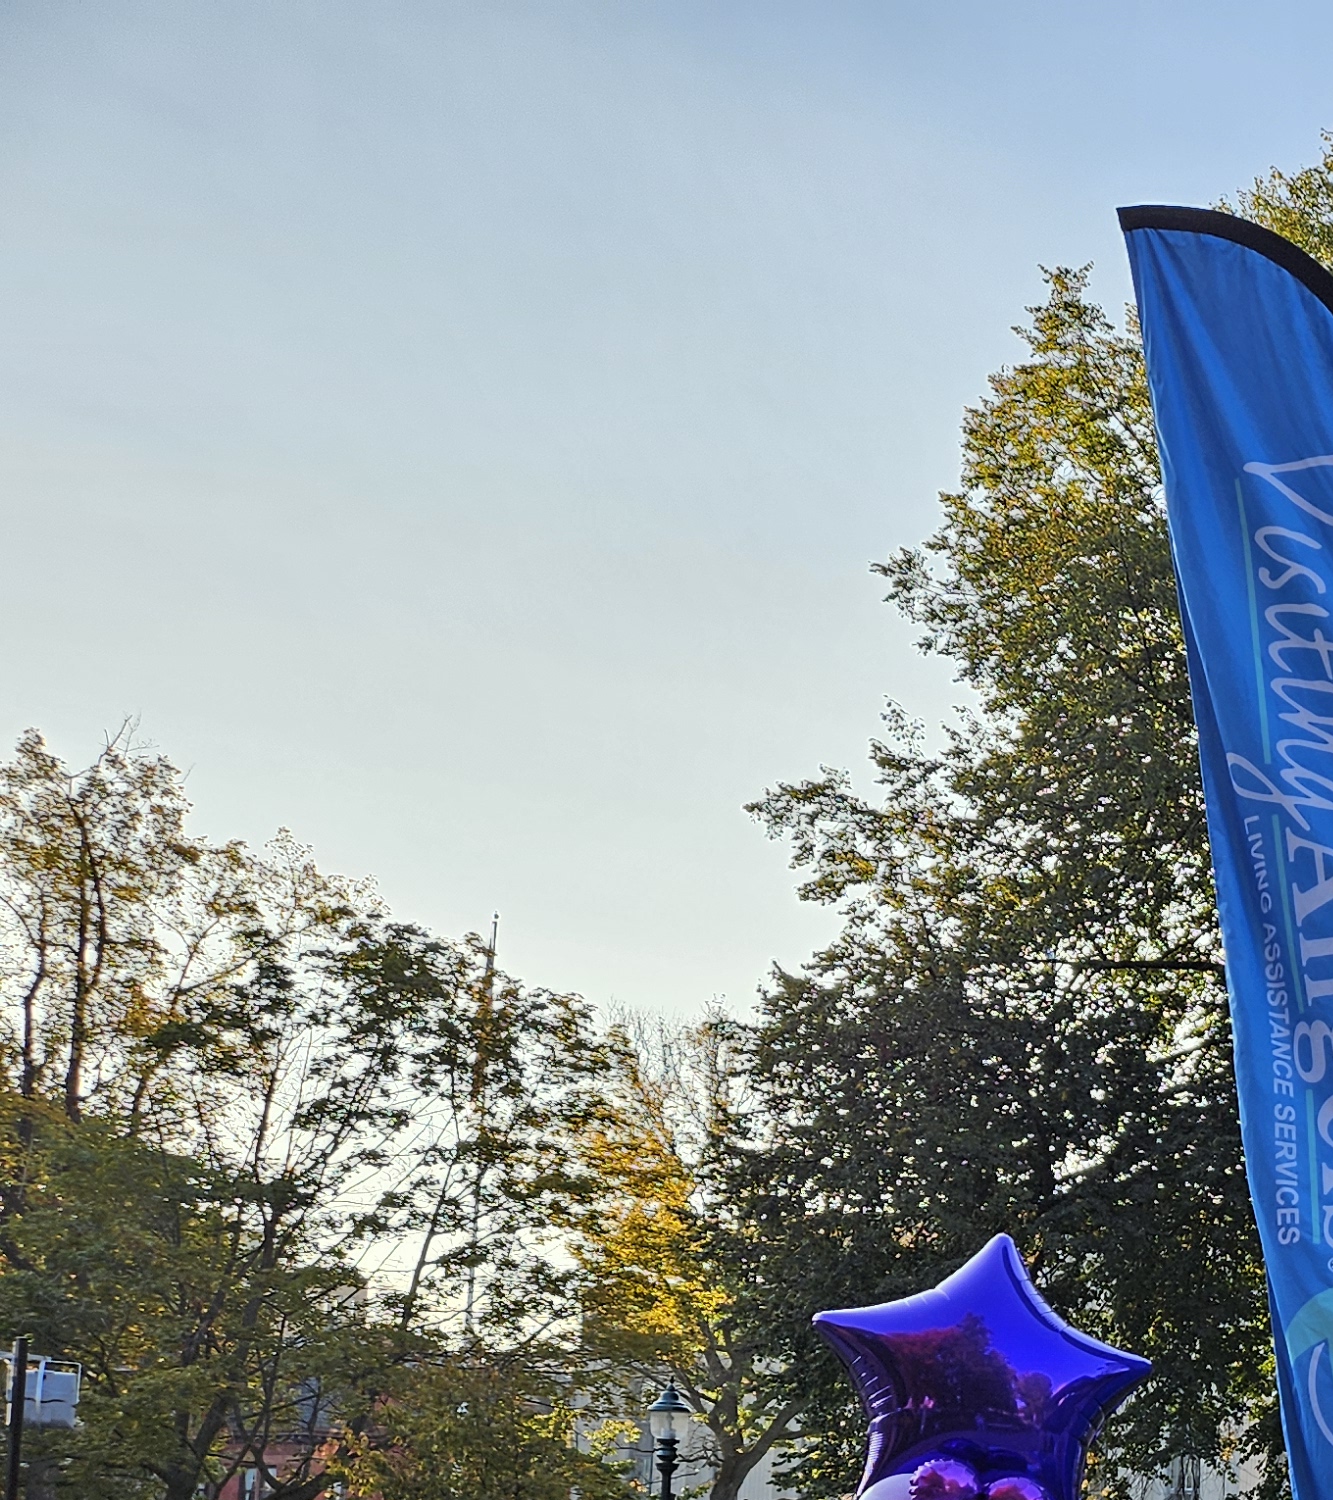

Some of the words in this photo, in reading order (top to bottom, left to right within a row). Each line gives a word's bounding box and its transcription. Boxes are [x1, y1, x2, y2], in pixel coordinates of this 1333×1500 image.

[1244, 814, 1271, 914] LIVING
[1262, 922, 1294, 1093] ASSISTANCE
[1273, 1102, 1300, 1246] SERVICES
